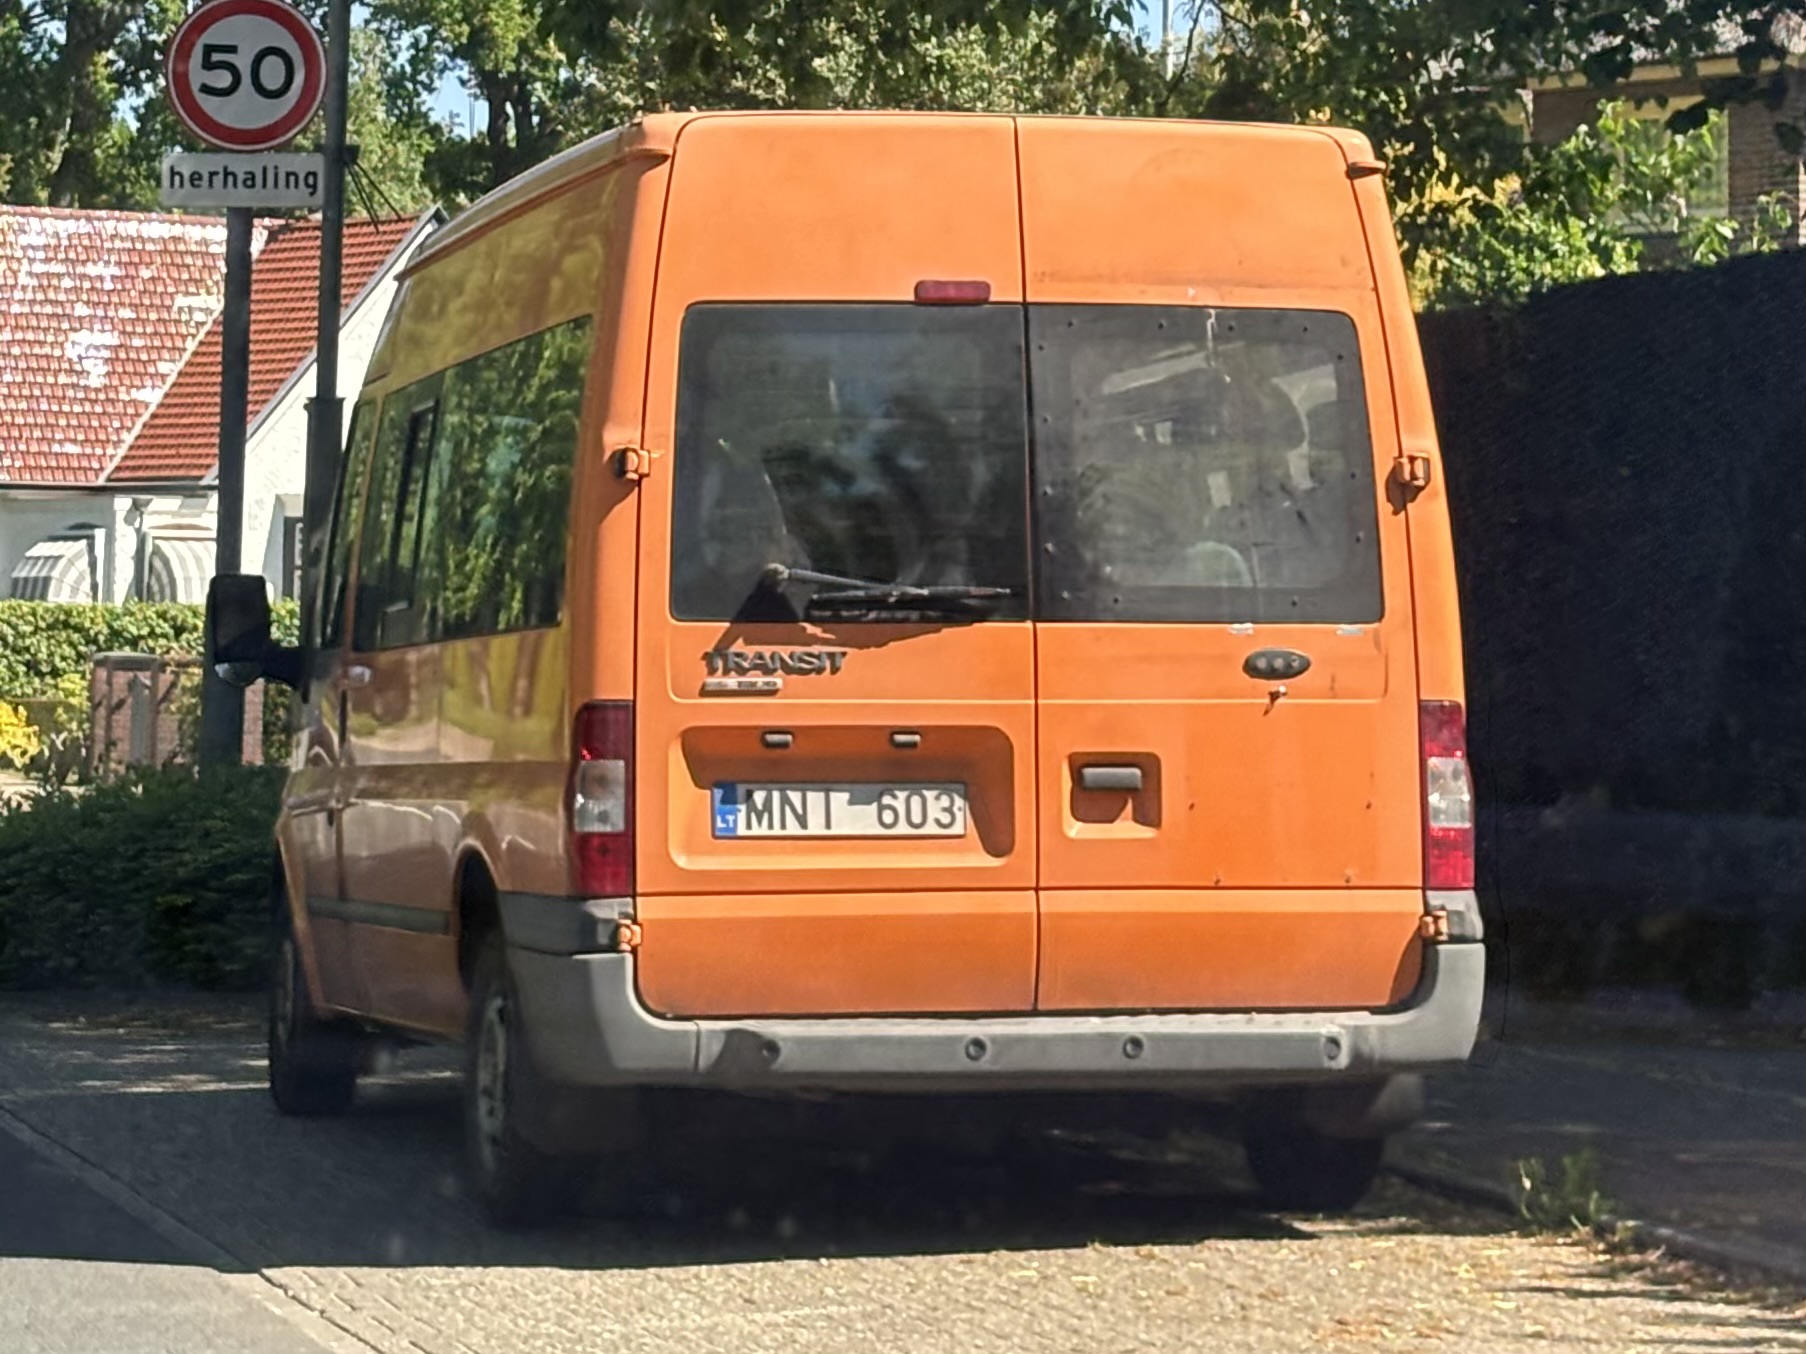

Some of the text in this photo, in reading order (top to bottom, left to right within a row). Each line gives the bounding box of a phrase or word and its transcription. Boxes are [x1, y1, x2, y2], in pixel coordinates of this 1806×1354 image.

[198, 43, 295, 99] 50
[168, 165, 319, 197] herhaling
[702, 651, 848, 676] TRANSIT
[716, 814, 736, 829] LT
[876, 788, 957, 830] 603
